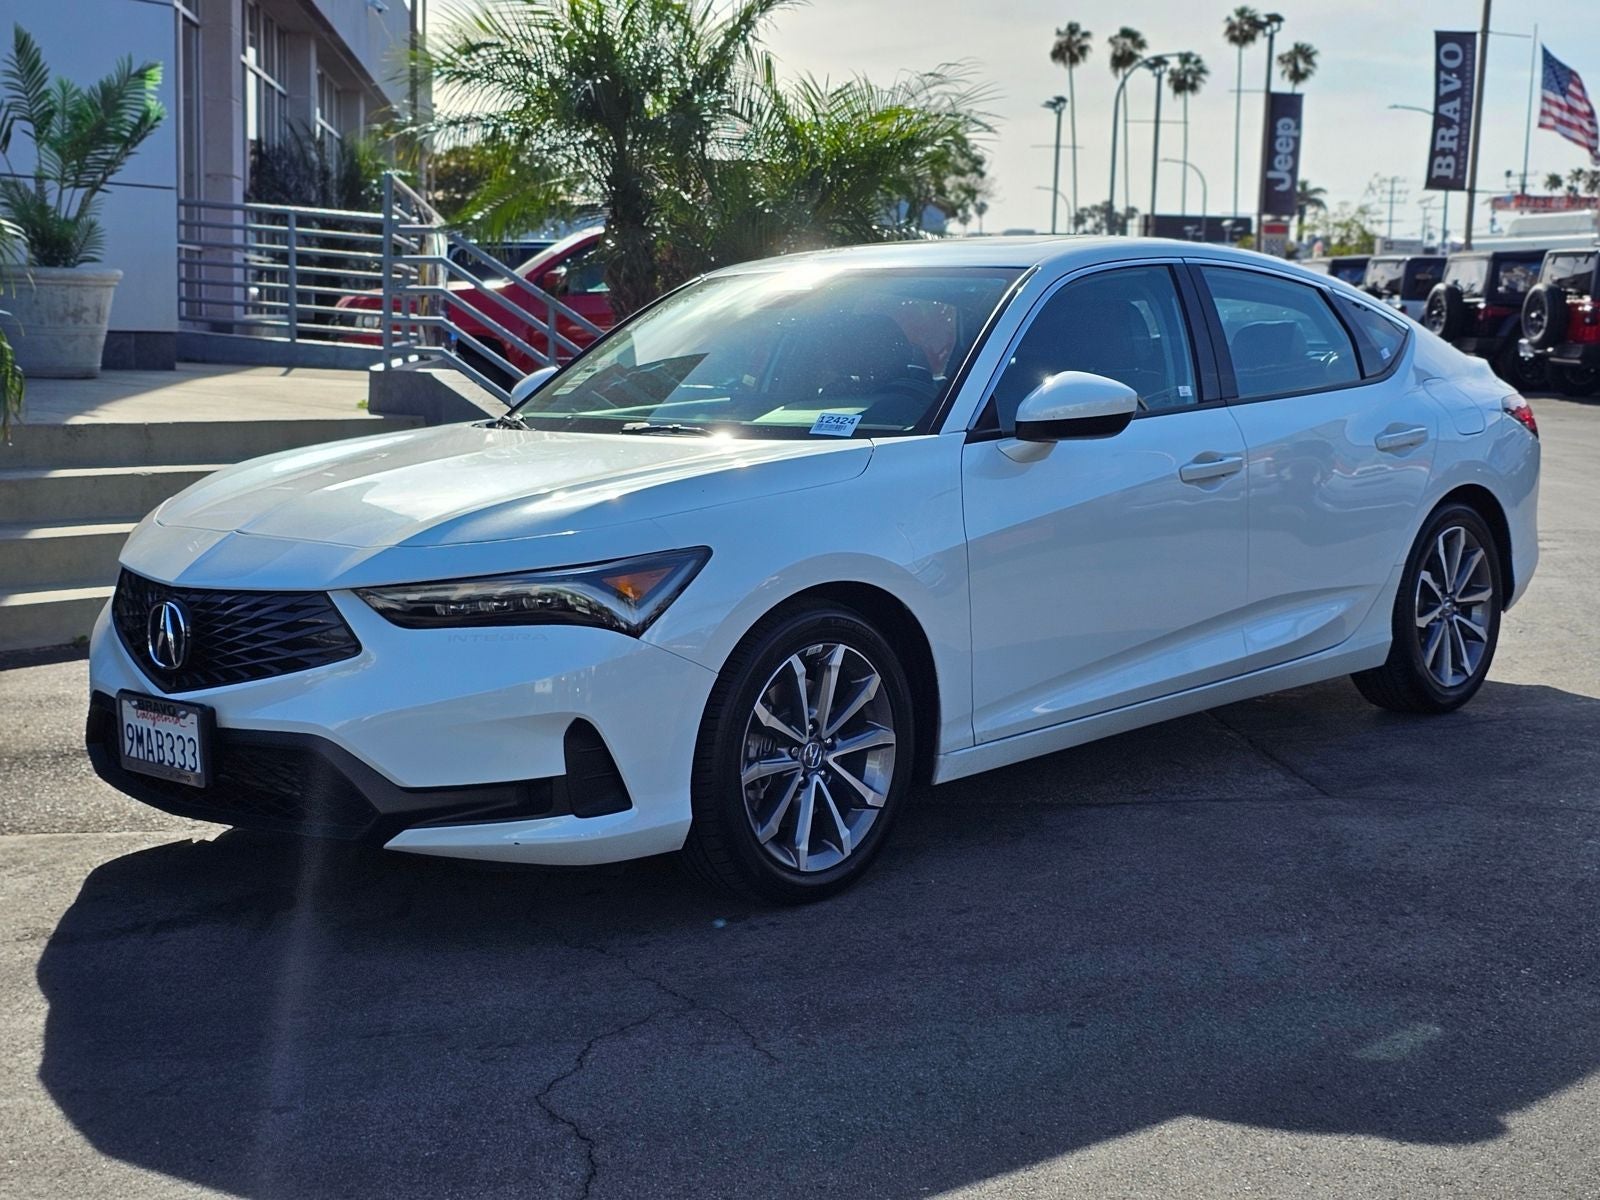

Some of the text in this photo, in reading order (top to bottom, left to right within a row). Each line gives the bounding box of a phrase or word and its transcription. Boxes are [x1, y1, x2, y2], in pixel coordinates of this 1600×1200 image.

[1432, 42, 1463, 179] BRAVO
[1267, 117, 1299, 191] Jeep
[819, 415, 856, 425] 12424
[126, 723, 198, 772] 9MAB333
